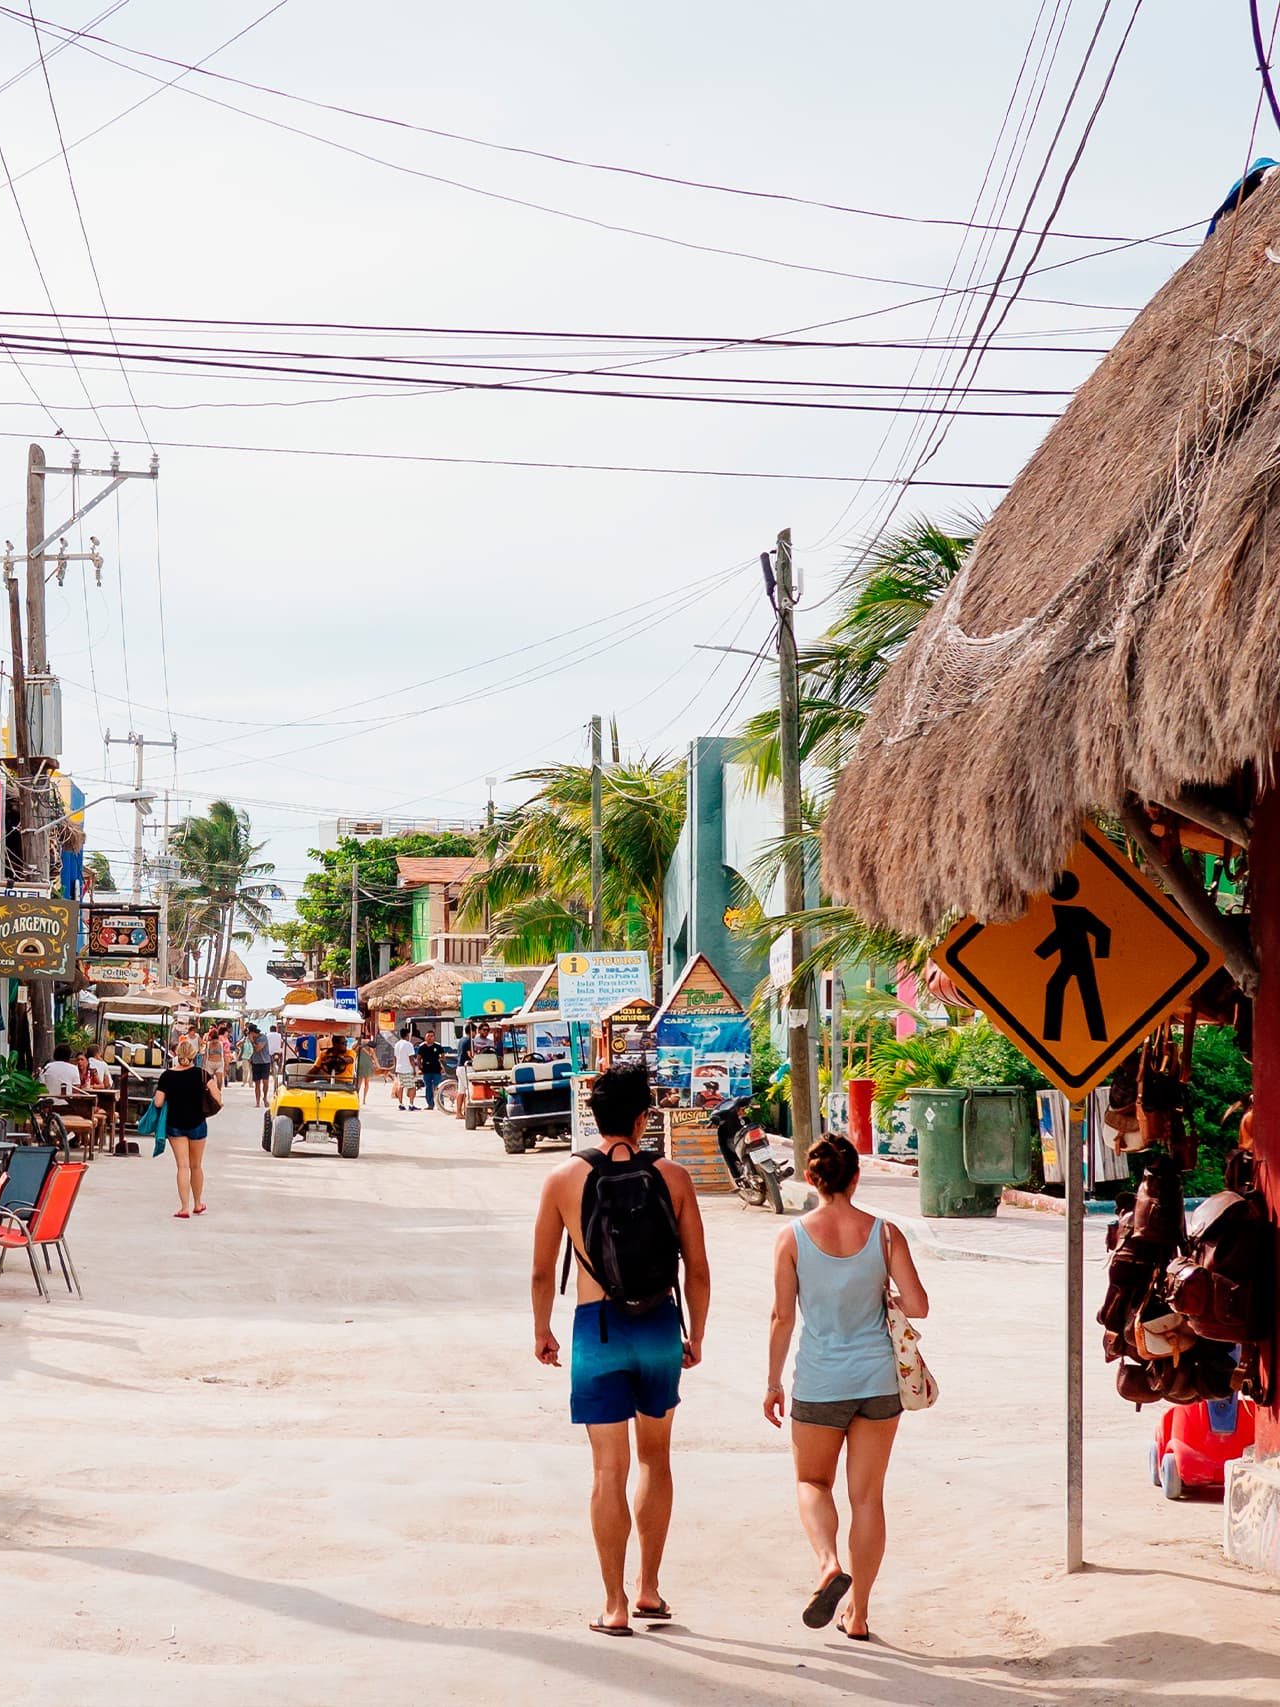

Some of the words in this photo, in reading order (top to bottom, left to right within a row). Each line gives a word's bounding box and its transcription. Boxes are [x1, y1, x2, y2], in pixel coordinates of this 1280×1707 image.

[11, 915, 60, 936] ARGENTO
[591, 956, 641, 966] TOURS
[680, 989, 724, 1007] Tour
